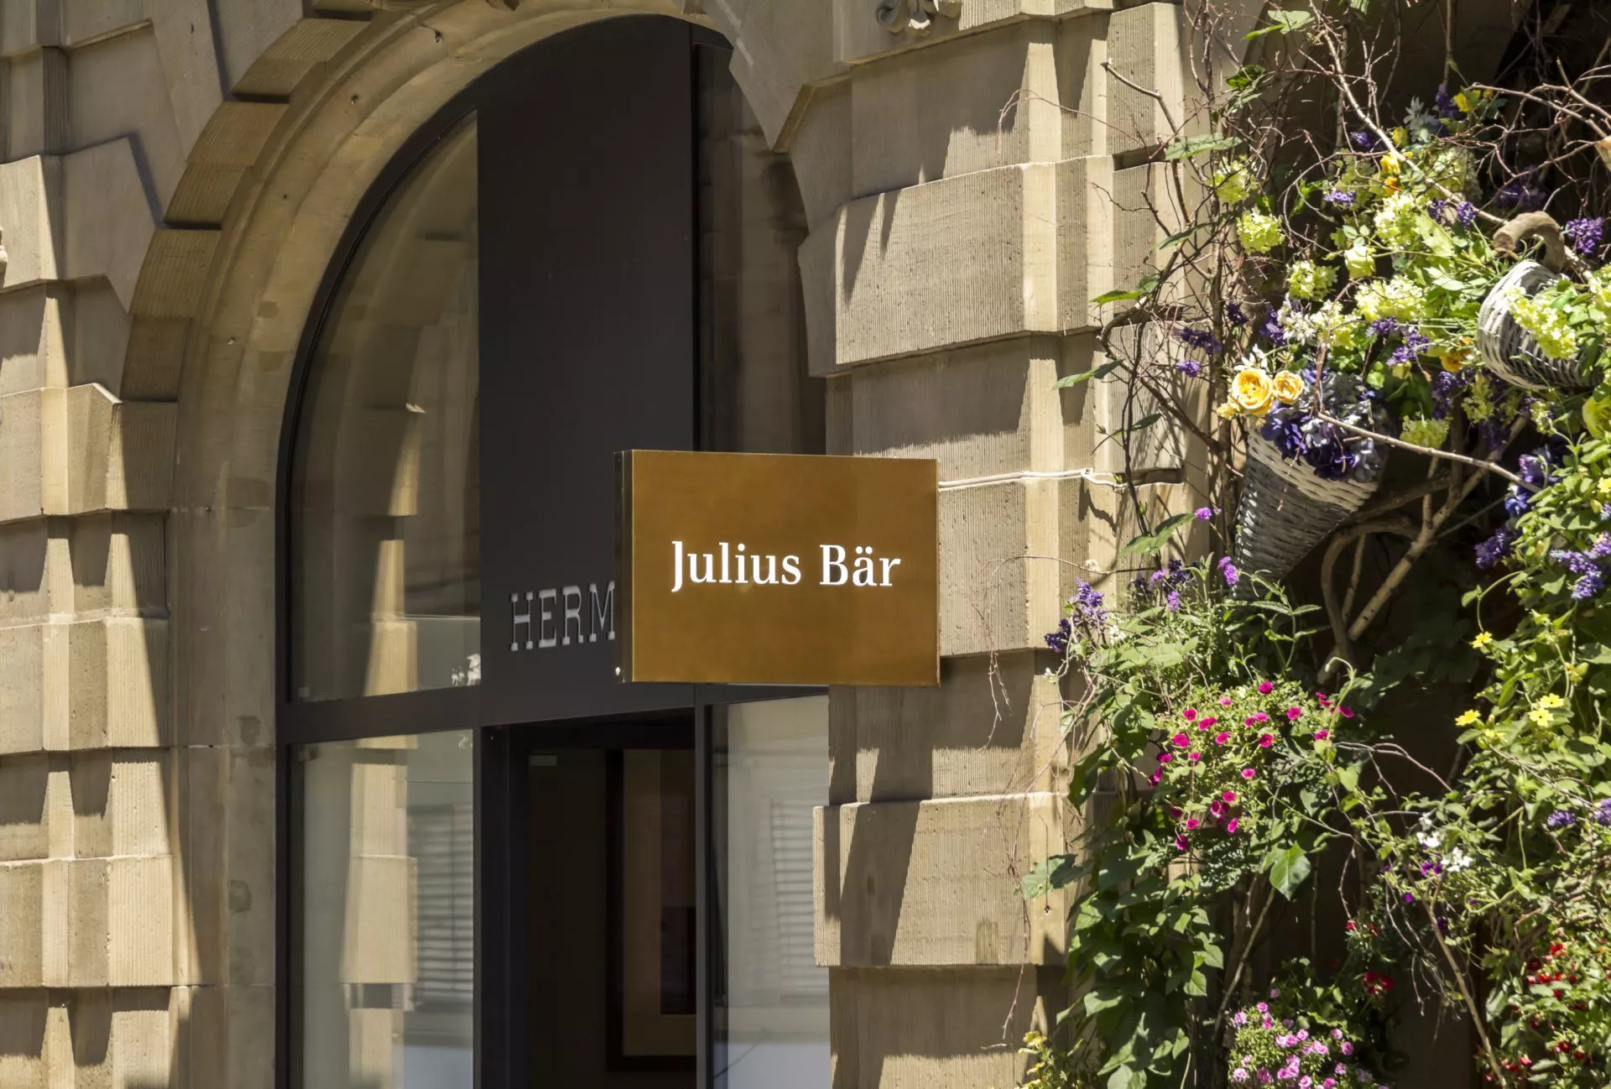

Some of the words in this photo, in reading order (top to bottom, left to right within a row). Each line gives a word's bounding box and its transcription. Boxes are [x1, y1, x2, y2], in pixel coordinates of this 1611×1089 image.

[671, 540, 802, 593] Julius
[819, 544, 902, 587] Bär
[510, 580, 616, 652] HERM
